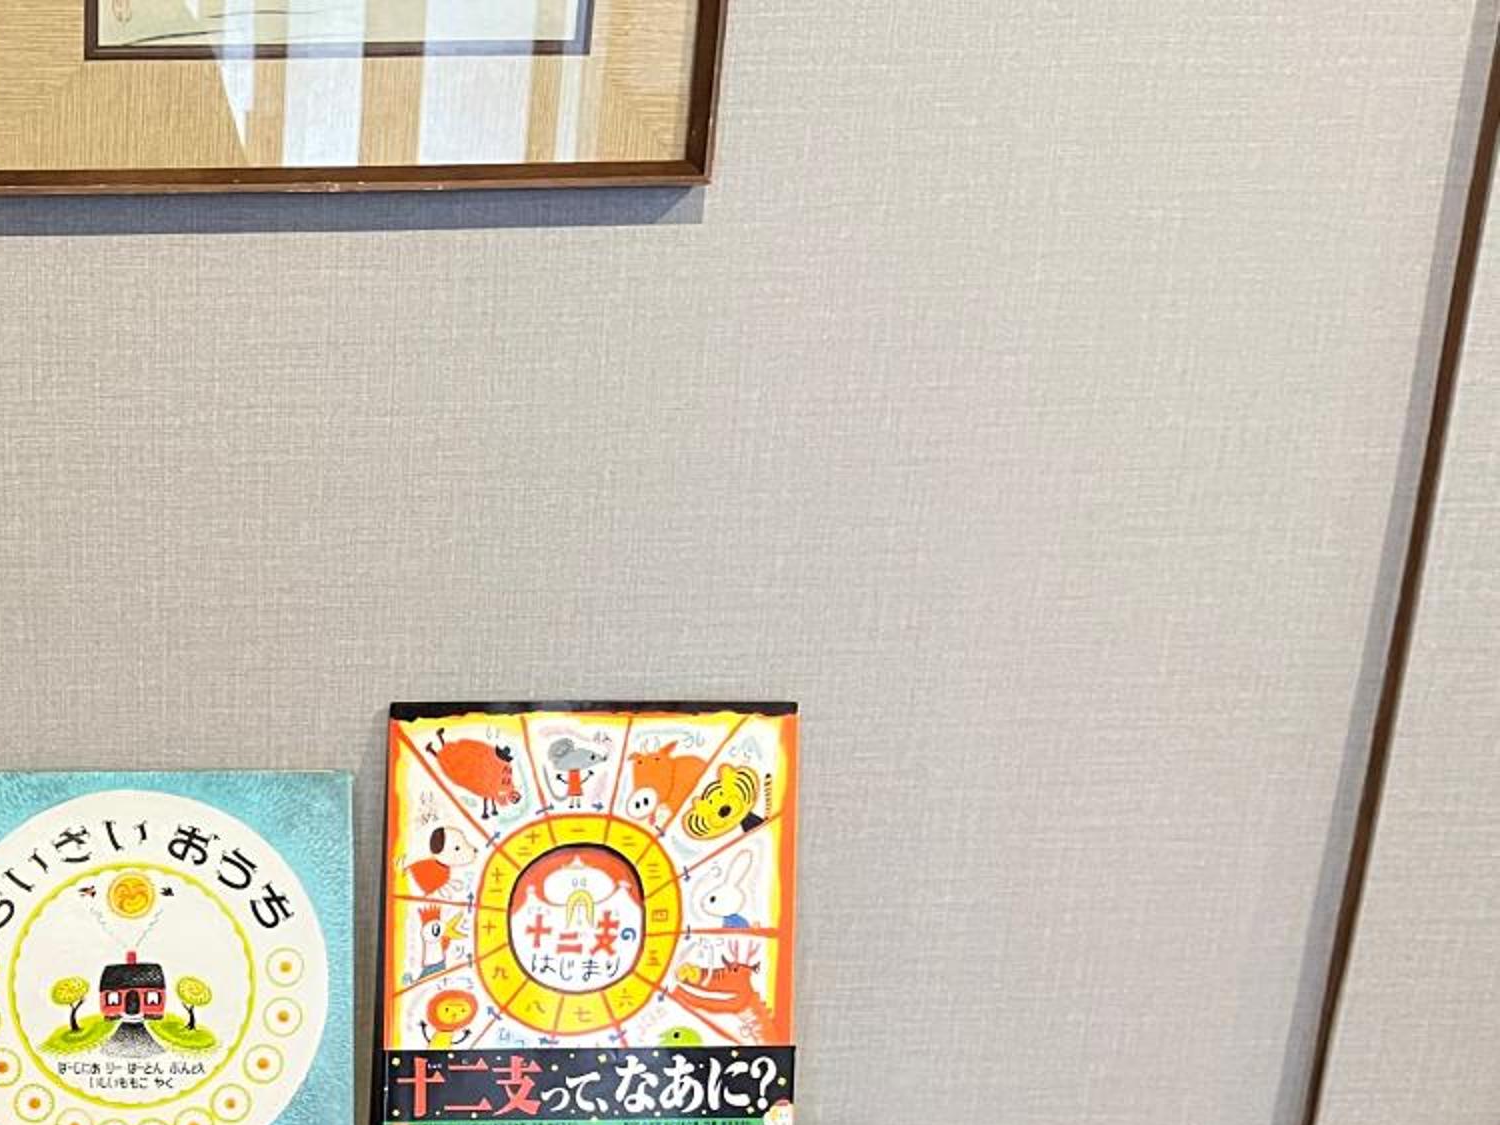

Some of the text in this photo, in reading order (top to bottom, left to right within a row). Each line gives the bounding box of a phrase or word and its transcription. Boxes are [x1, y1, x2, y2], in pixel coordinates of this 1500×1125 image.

[167, 824, 294, 931] おうち
[532, 954, 621, 982] はじまり
[89, 1077, 149, 1089] いしいももこ
